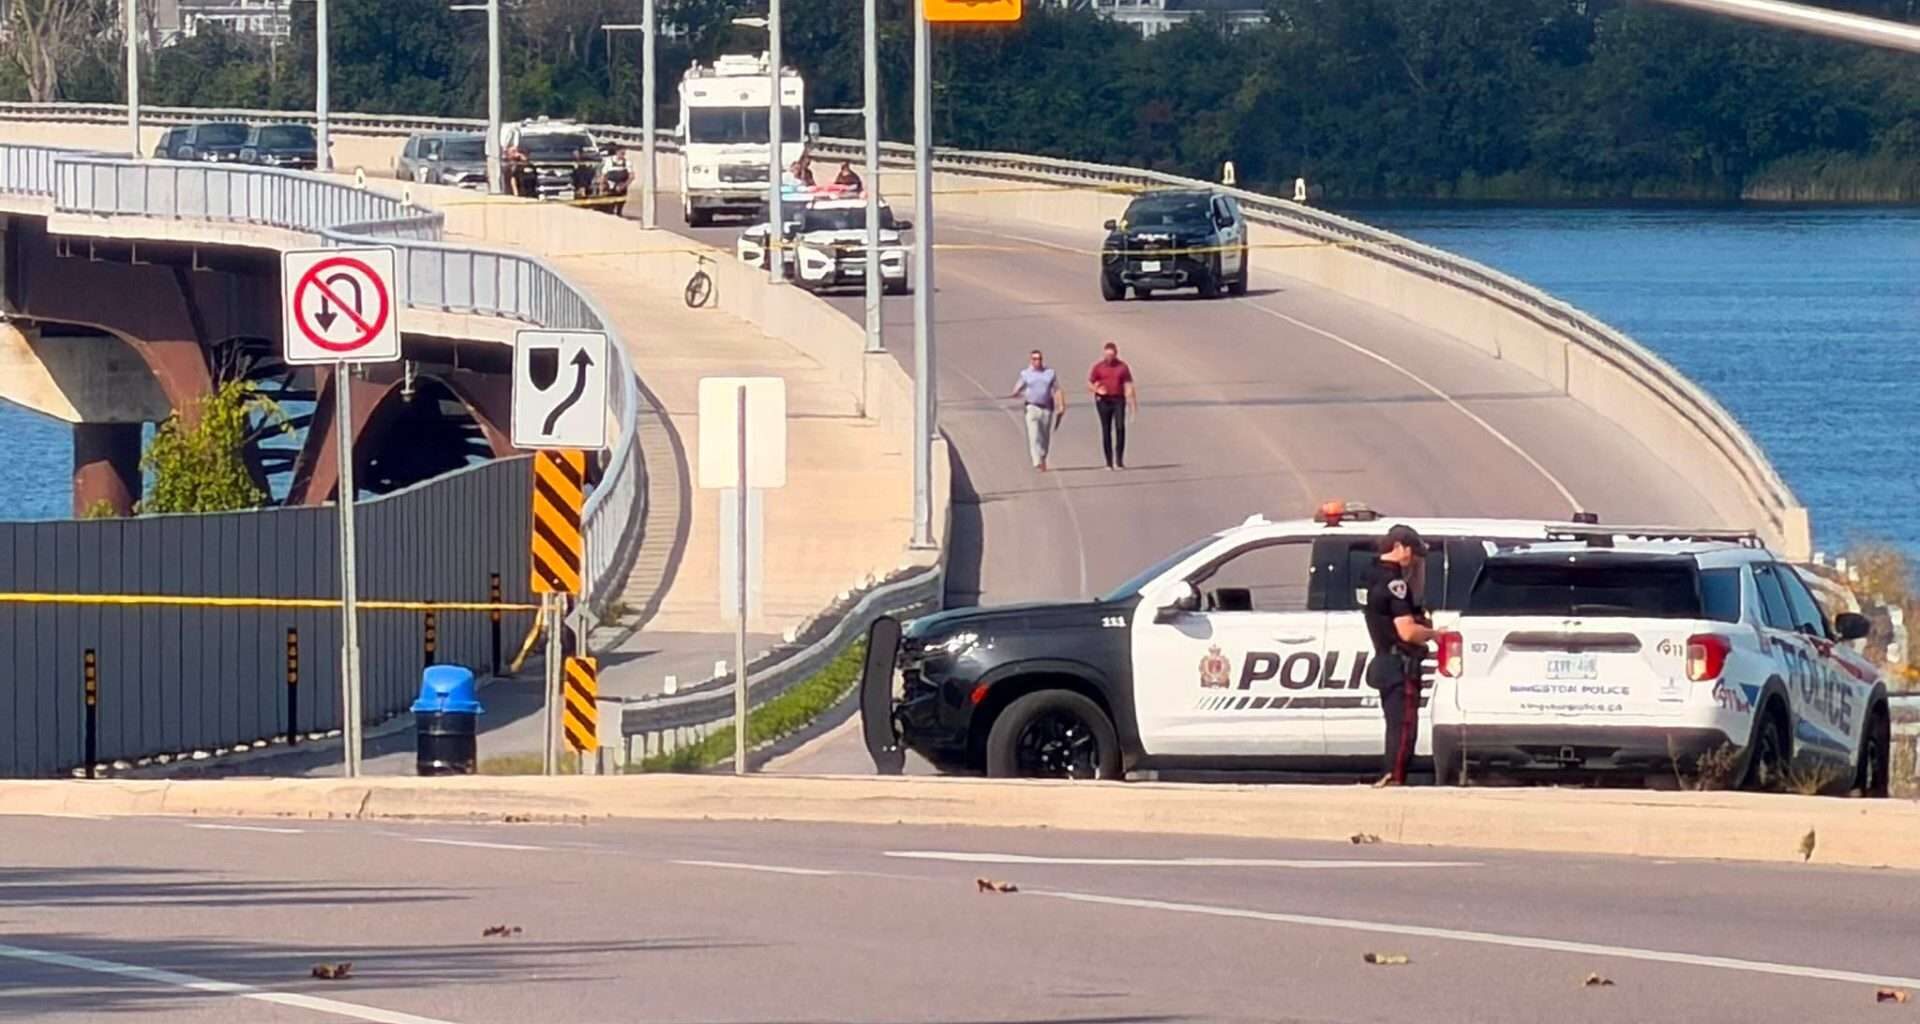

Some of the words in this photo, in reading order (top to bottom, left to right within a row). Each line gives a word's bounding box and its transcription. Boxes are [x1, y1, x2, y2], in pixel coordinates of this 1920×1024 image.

[1101, 616, 1127, 627] 111
[1660, 642, 1683, 656] 911
[1237, 651, 1437, 690] POLIE
[1509, 684, 1577, 694] GSTON
[1582, 685, 1630, 695] POLICE
[1775, 637, 1853, 736] POLICE
